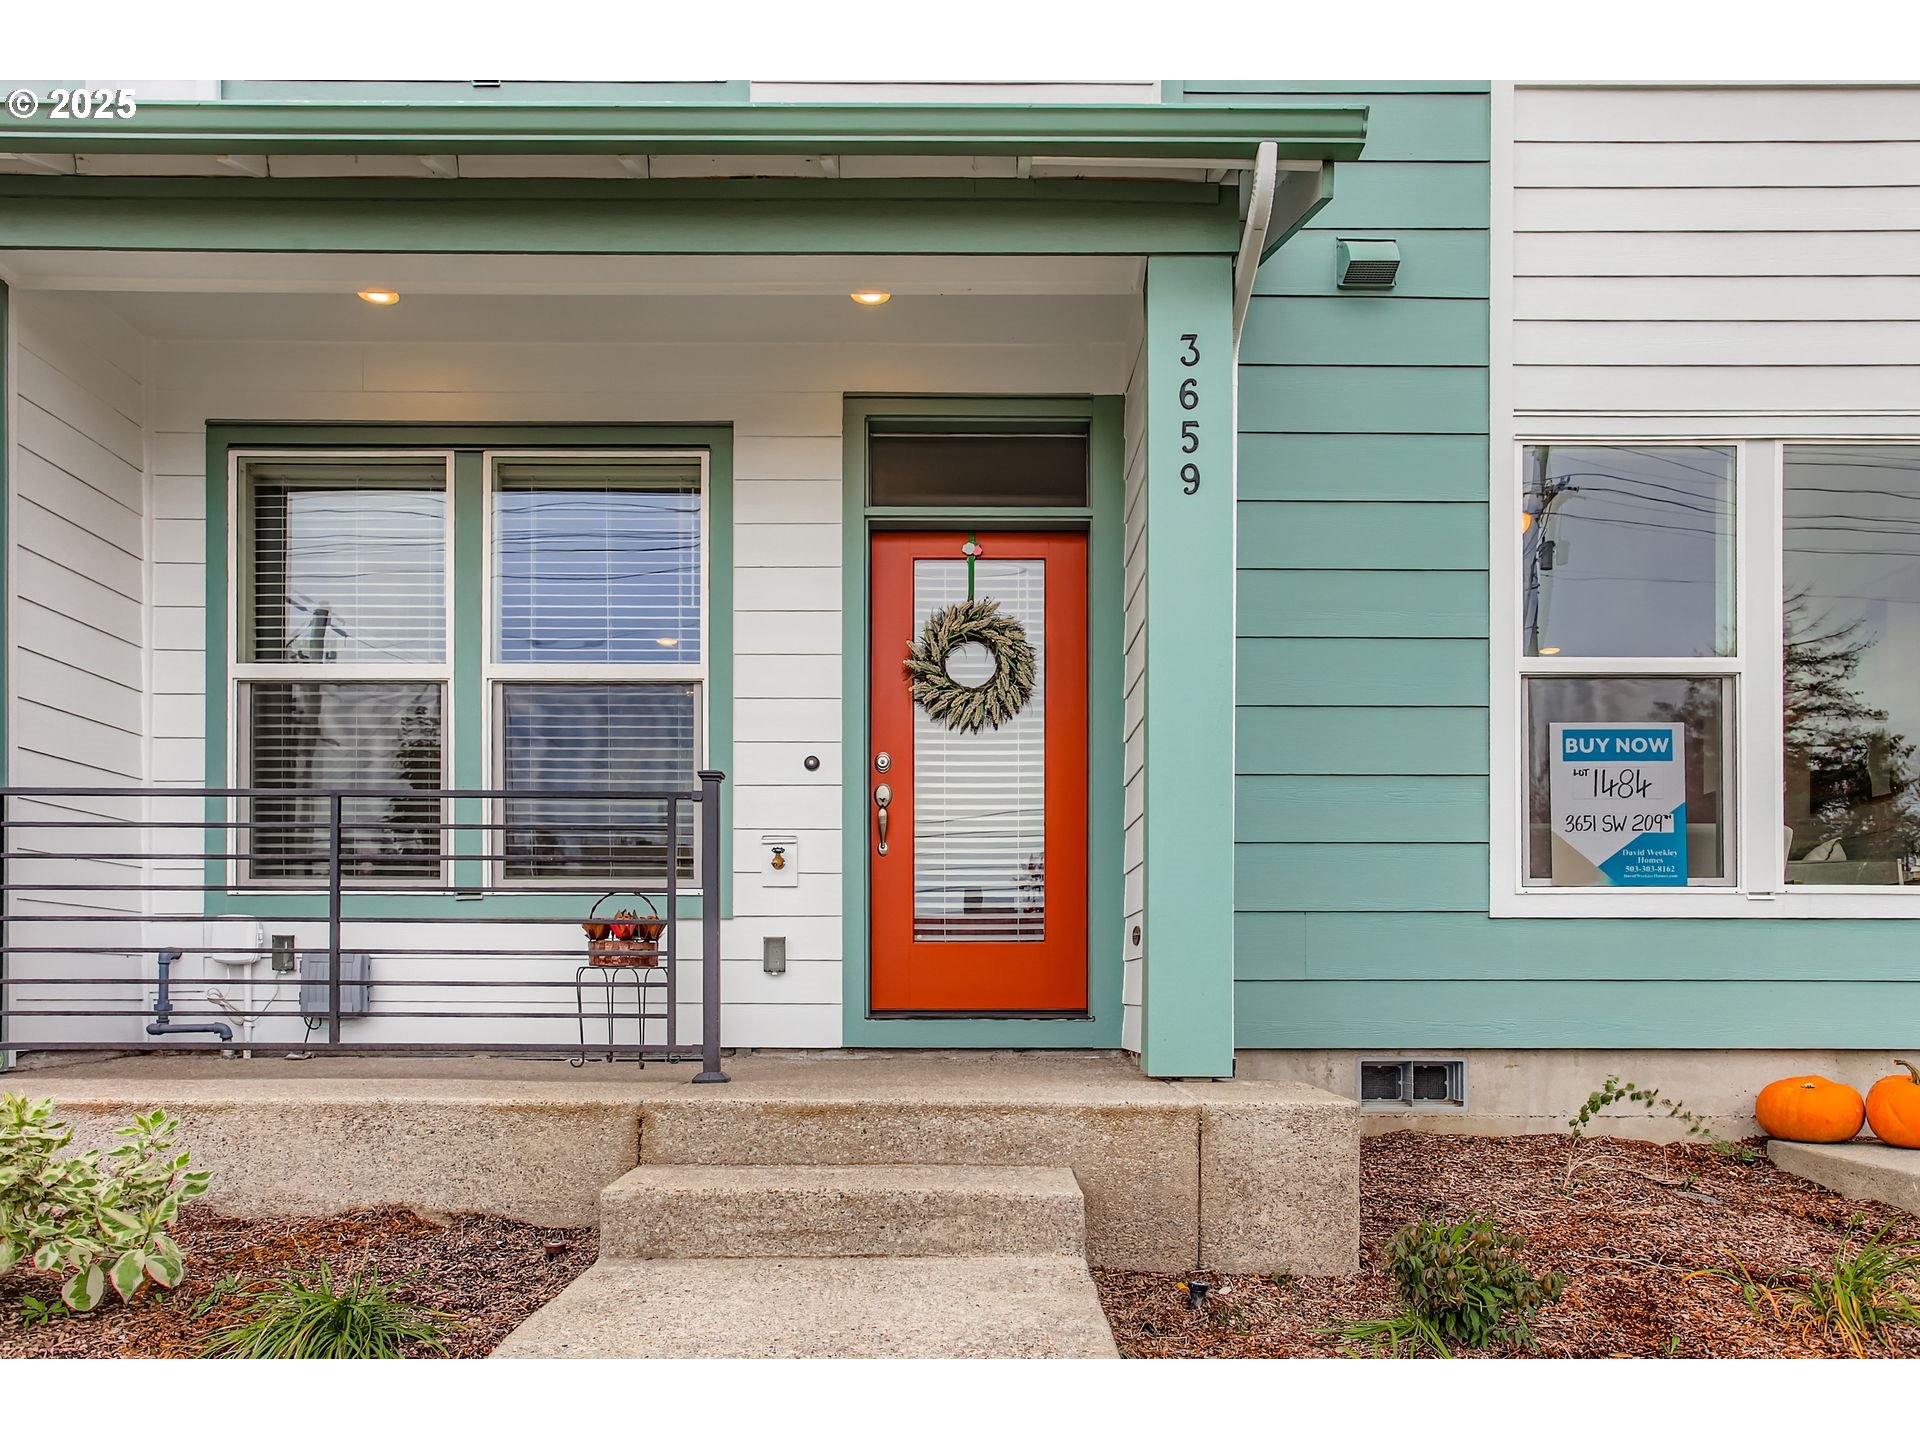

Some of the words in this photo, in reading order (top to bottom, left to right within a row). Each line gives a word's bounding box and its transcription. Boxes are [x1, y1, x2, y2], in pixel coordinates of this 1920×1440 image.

[1179, 334, 1200, 495] 3659
[1565, 737, 1610, 754] BUY
[1615, 737, 1669, 754] NOW
[1573, 768, 1590, 777] LOT
[1593, 768, 1652, 799] 1484
[1564, 814, 1597, 833] 3651
[1602, 814, 1628, 833] SW
[1622, 848, 1645, 857] David
[1646, 848, 1678, 858] Weekley
[1637, 856, 1664, 864] Homes
[1625, 865, 1676, 873] 503-303-8162
